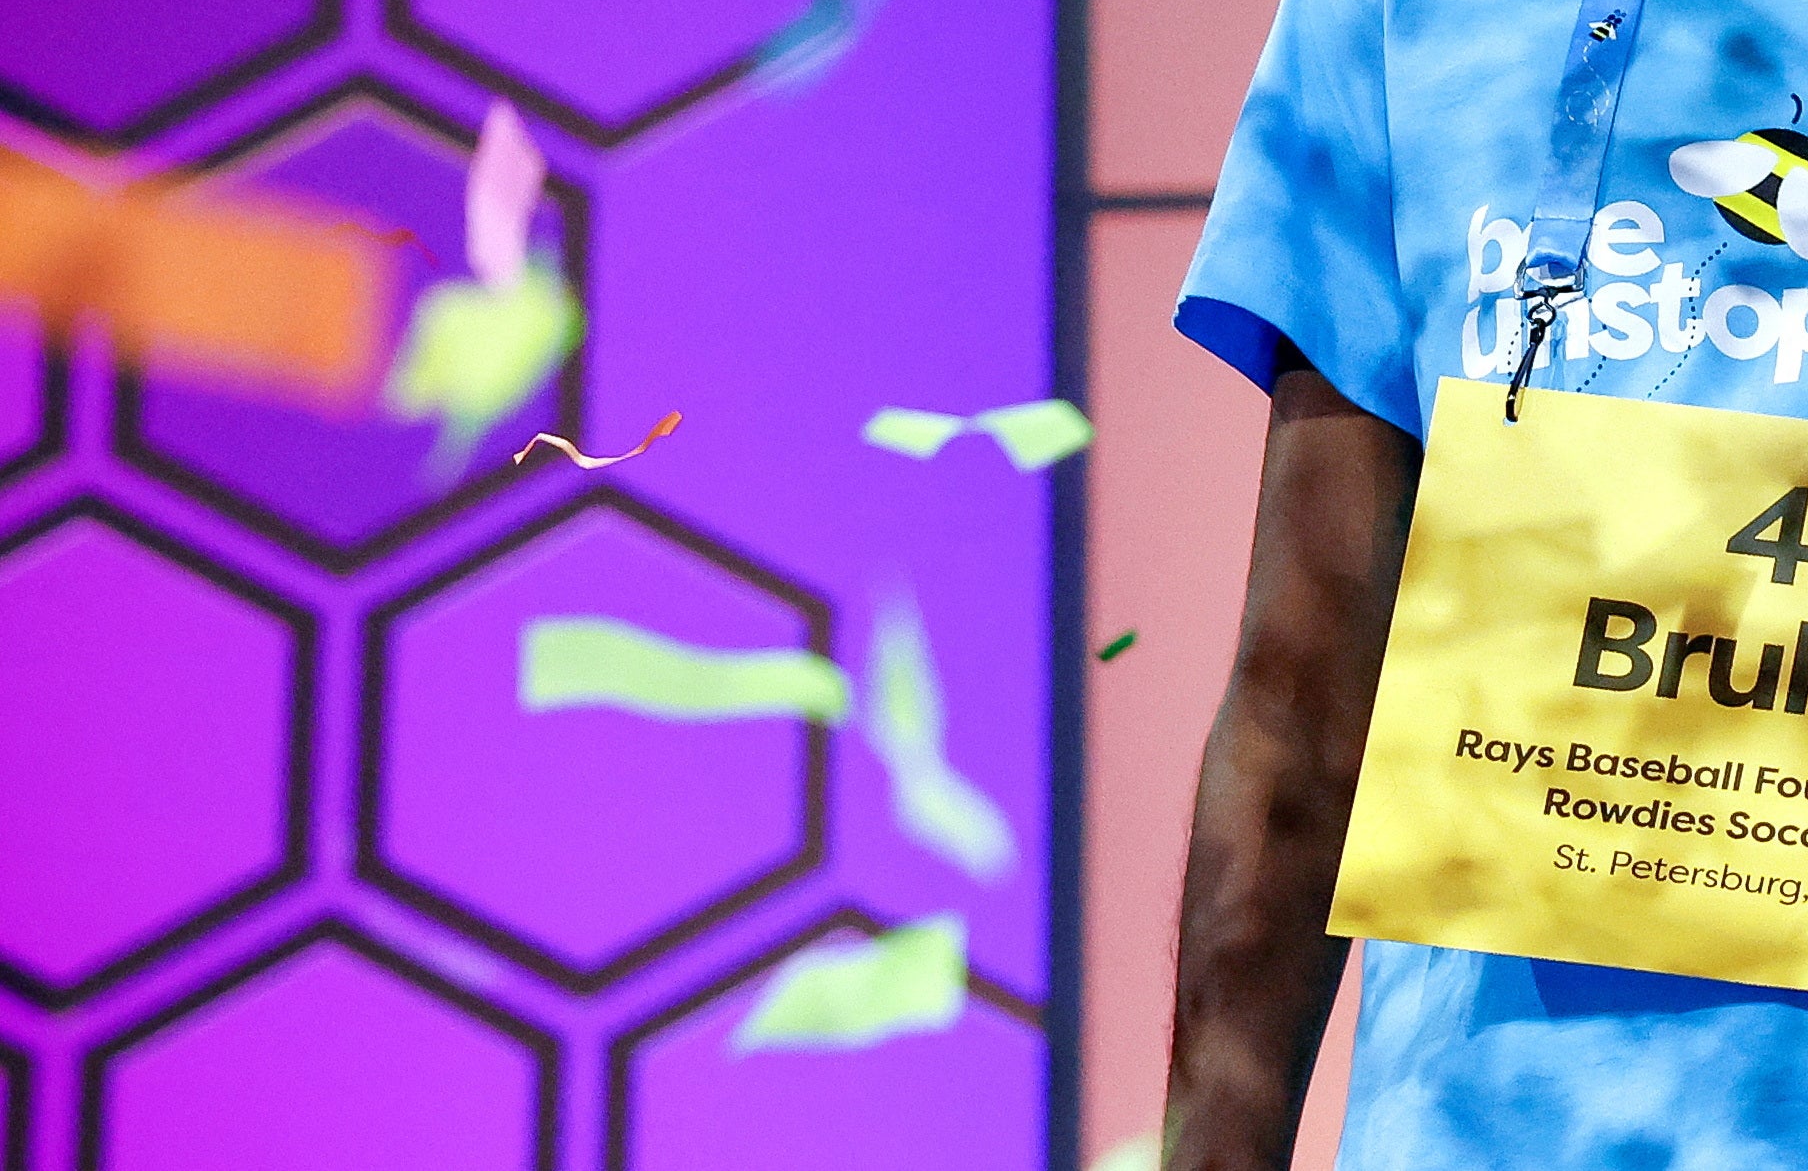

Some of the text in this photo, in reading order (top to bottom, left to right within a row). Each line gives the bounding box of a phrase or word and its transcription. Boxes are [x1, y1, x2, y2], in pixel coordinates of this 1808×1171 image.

[1455, 728, 1555, 774] Rays
[1565, 742, 1745, 792] Baseball
[1543, 786, 1717, 836] Rowdies
[1553, 844, 1596, 873] St.
[1609, 850, 1808, 906] Petersburg,
